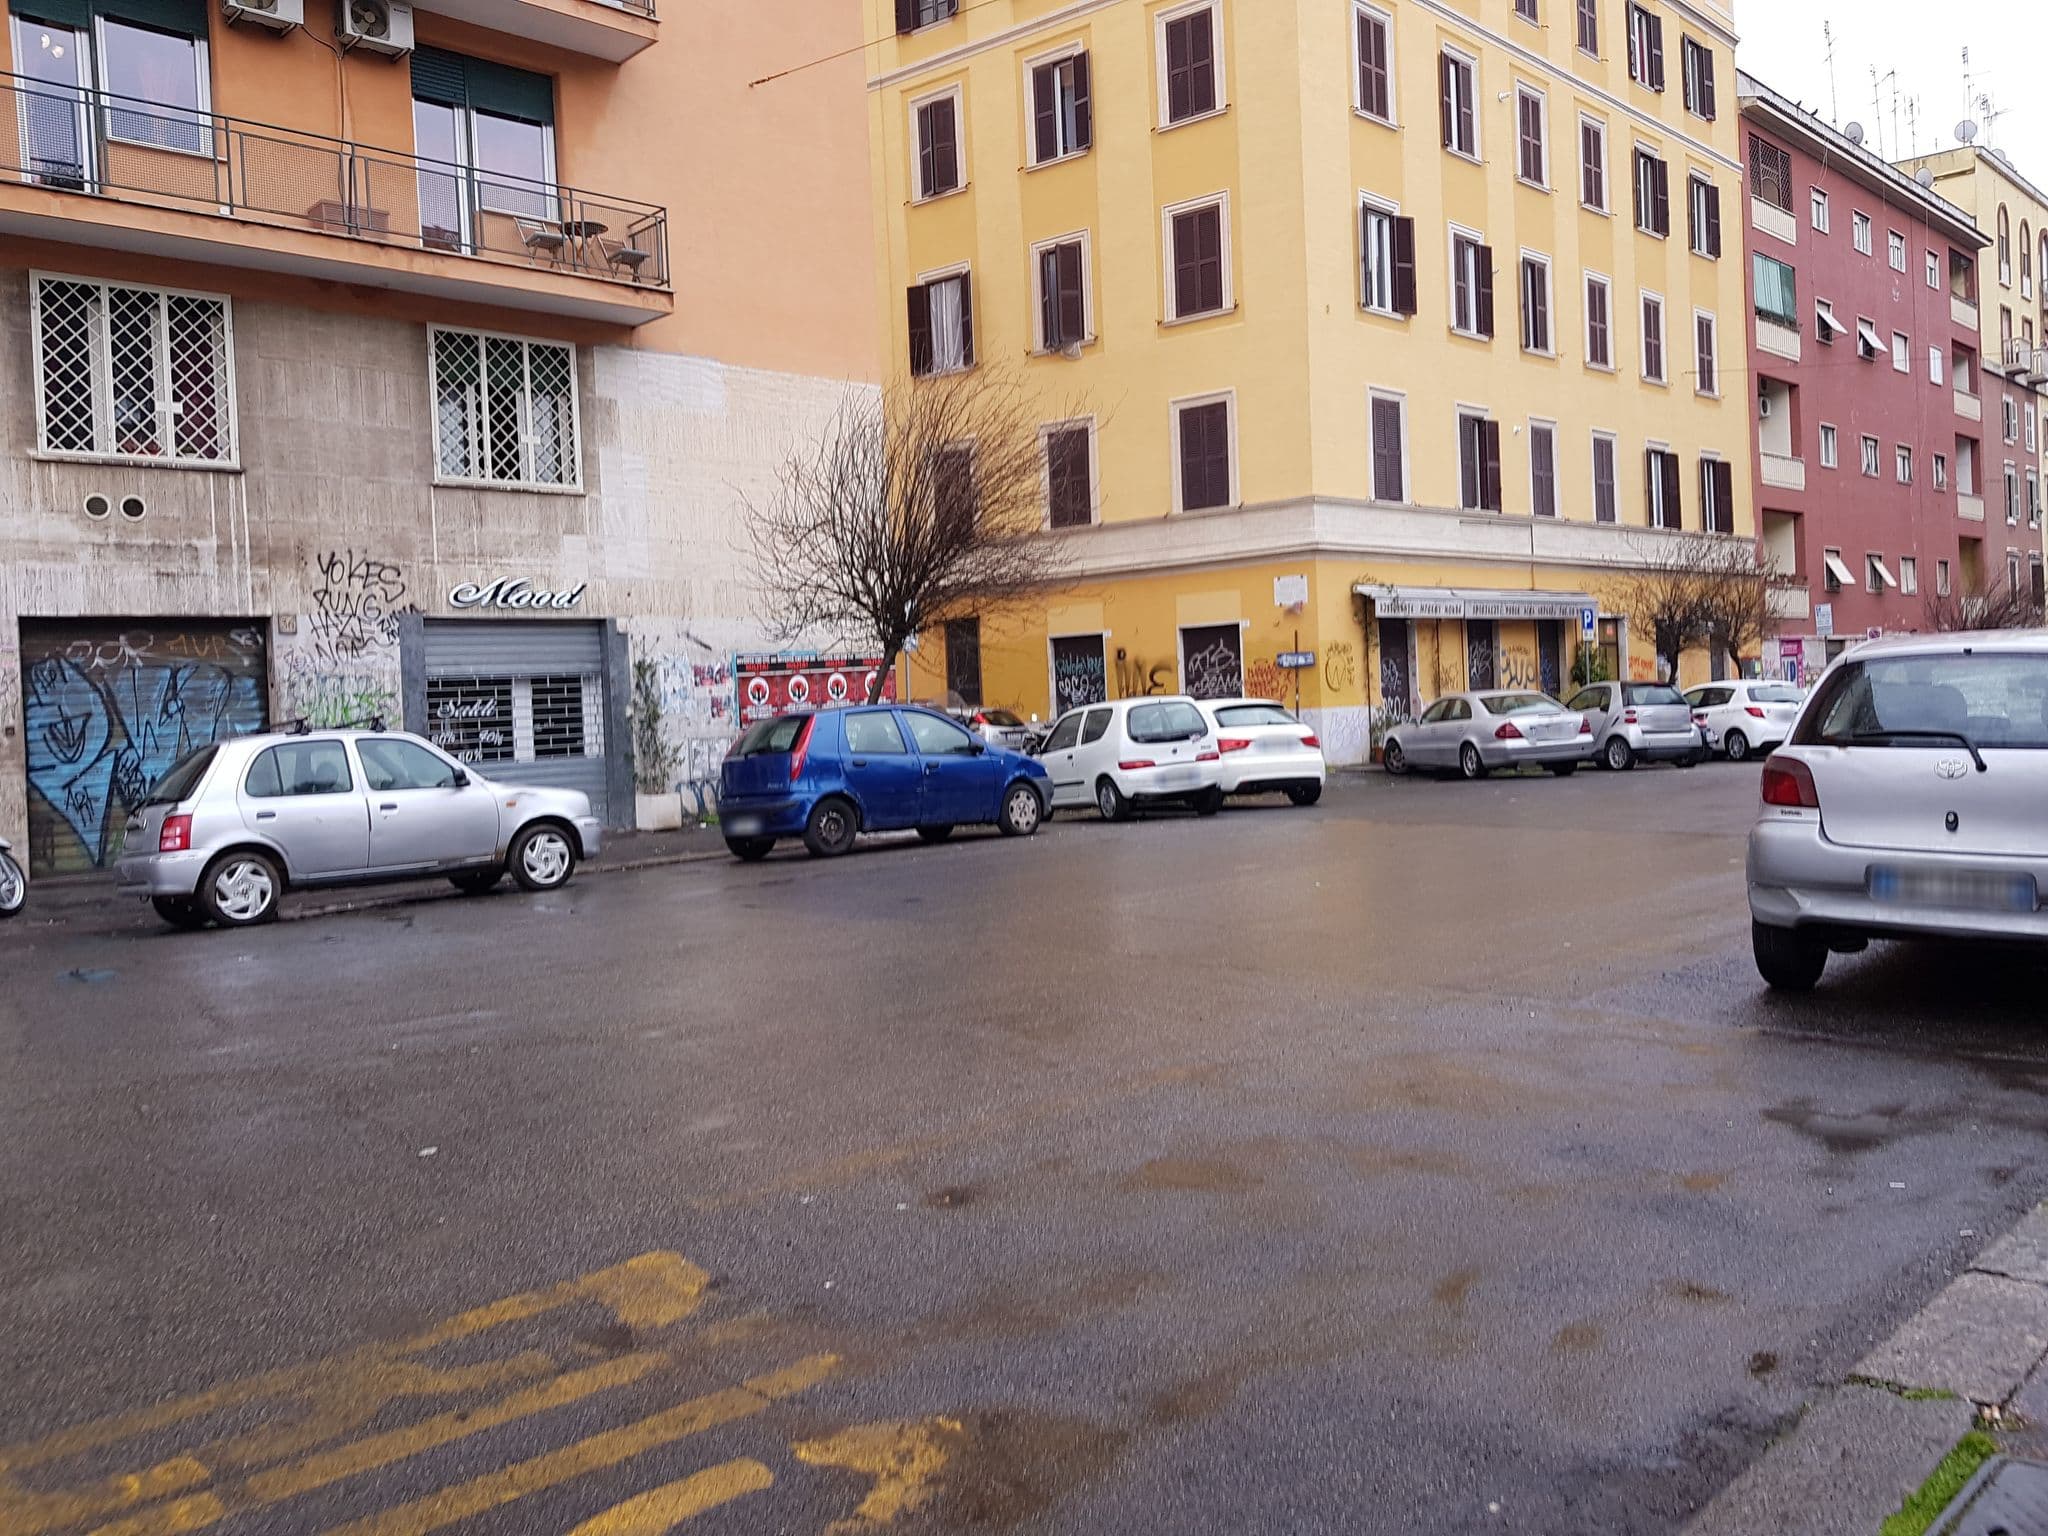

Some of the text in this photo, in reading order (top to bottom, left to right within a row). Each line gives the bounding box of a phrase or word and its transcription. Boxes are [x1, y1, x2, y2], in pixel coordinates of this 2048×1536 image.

[317, 549, 406, 604] YOKES
[449, 575, 588, 610] Mood
[1583, 609, 1592, 629] P
